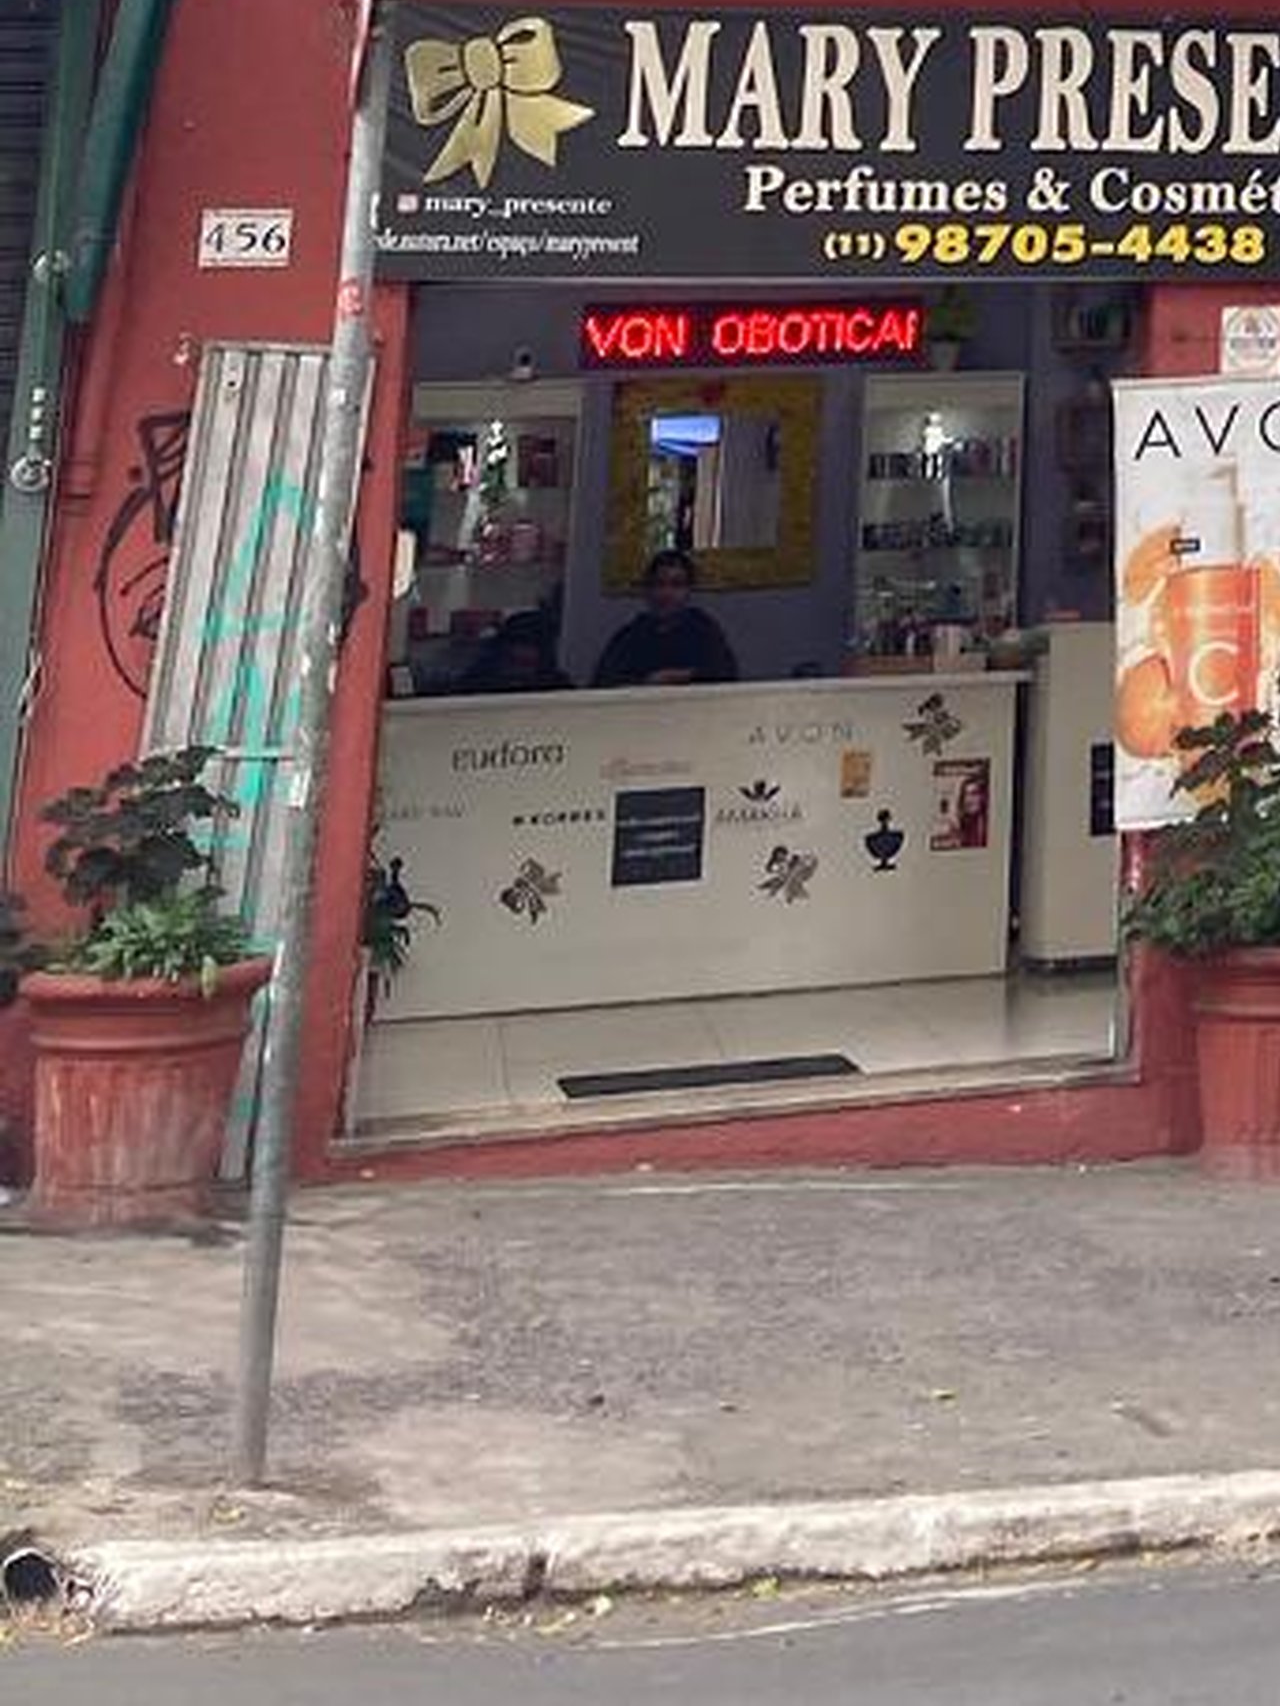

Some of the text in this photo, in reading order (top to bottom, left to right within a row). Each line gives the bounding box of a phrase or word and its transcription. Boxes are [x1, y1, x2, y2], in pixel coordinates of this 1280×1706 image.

[617, 20, 942, 151] MARY
[743, 165, 1007, 213] Perfumes
[1027, 166, 1071, 213] &
[203, 221, 288, 255] 456
[824, 223, 1266, 265] (11) 98705-4438
[585, 314, 688, 358] VON
[453, 740, 565, 772] eudora
